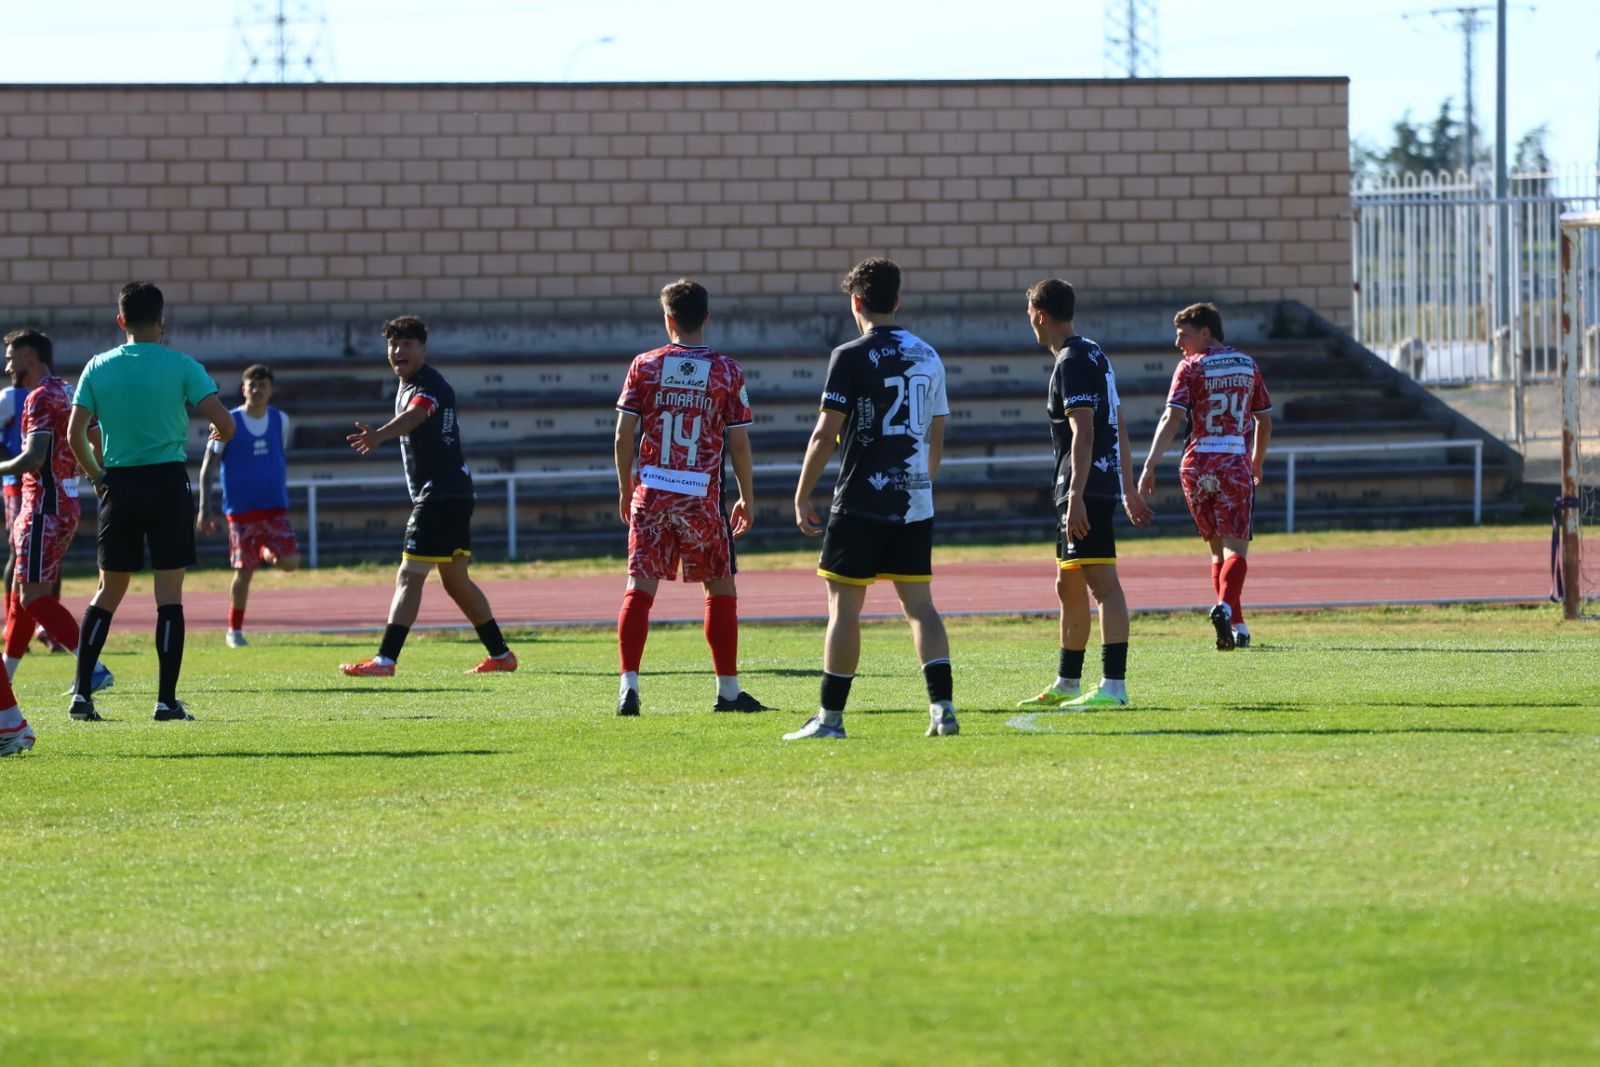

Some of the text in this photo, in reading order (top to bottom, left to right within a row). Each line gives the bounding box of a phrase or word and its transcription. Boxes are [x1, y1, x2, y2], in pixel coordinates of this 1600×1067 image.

[882, 373, 931, 436] 20
[1205, 392, 1249, 434] 24
[658, 410, 702, 467] 14
